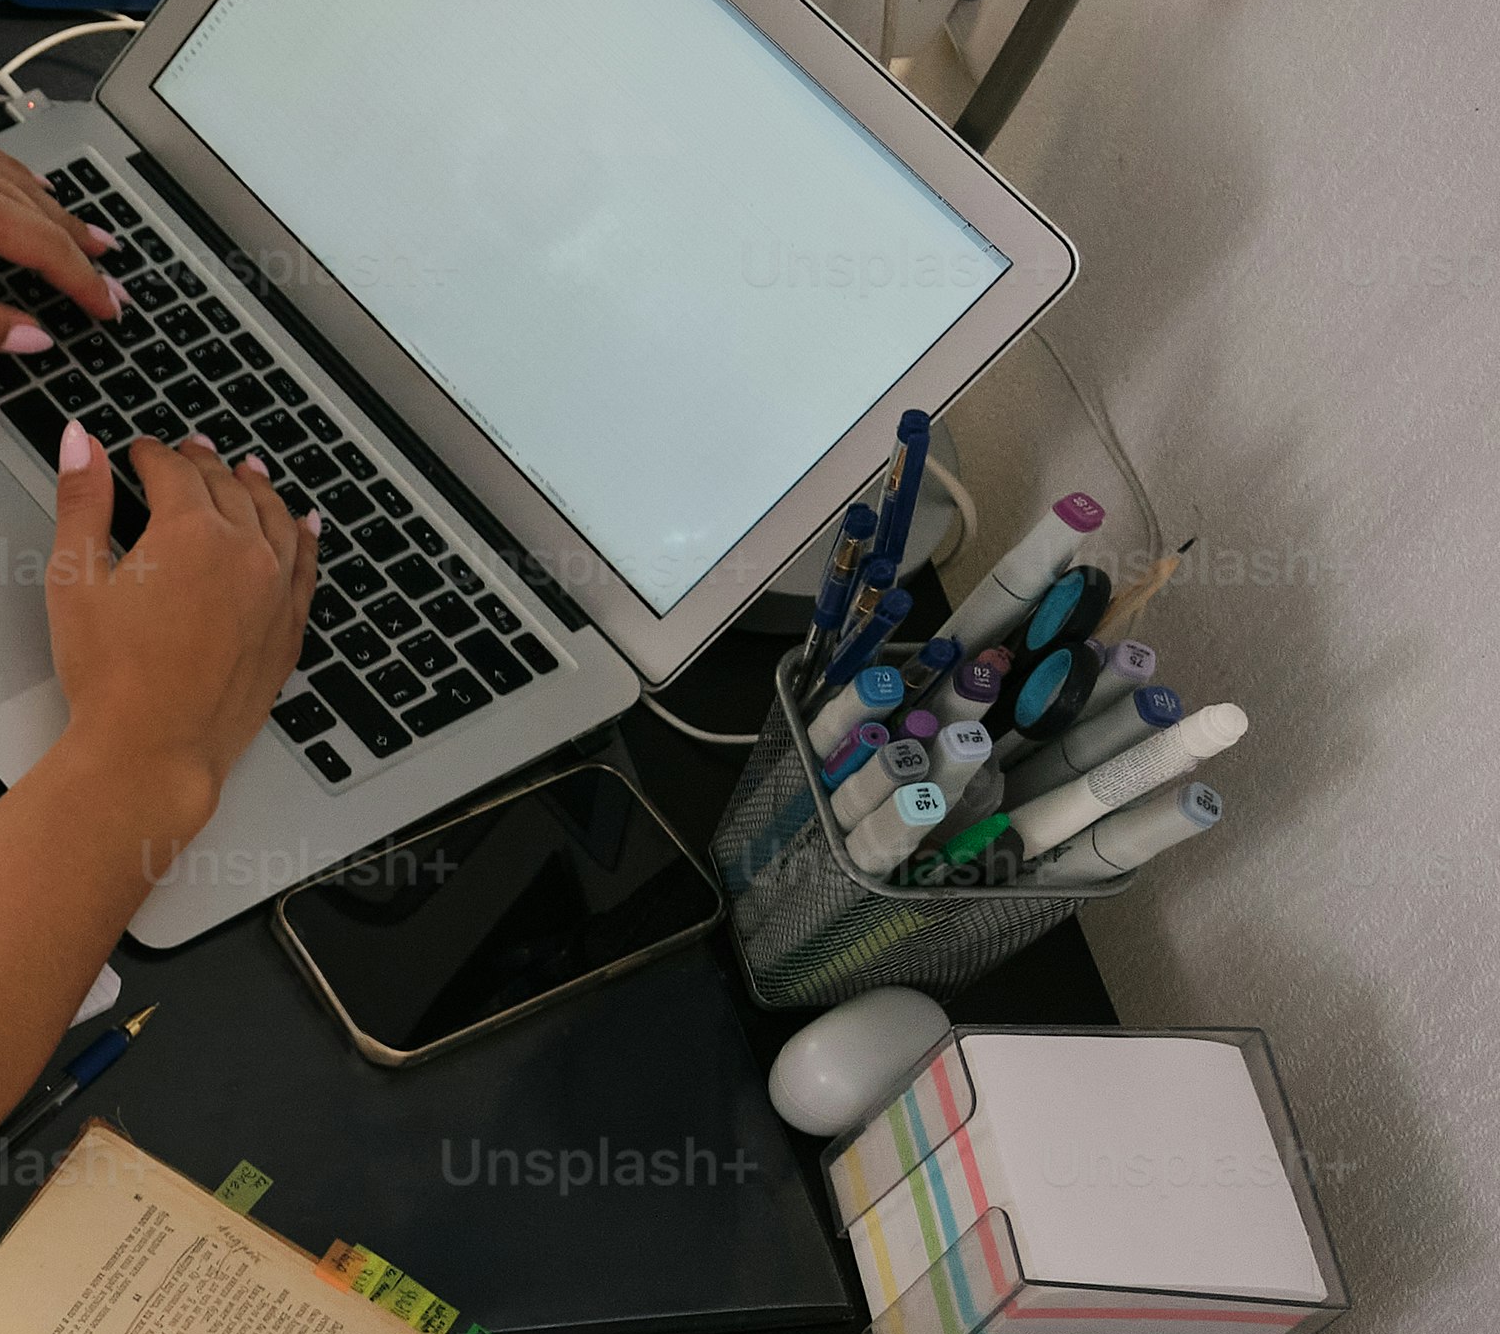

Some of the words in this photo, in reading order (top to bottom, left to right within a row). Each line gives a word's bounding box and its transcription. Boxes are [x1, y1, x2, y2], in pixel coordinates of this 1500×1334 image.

[969, 729, 983, 743] 76
[895, 755, 922, 768] CG4
[915, 799, 938, 810] 143
